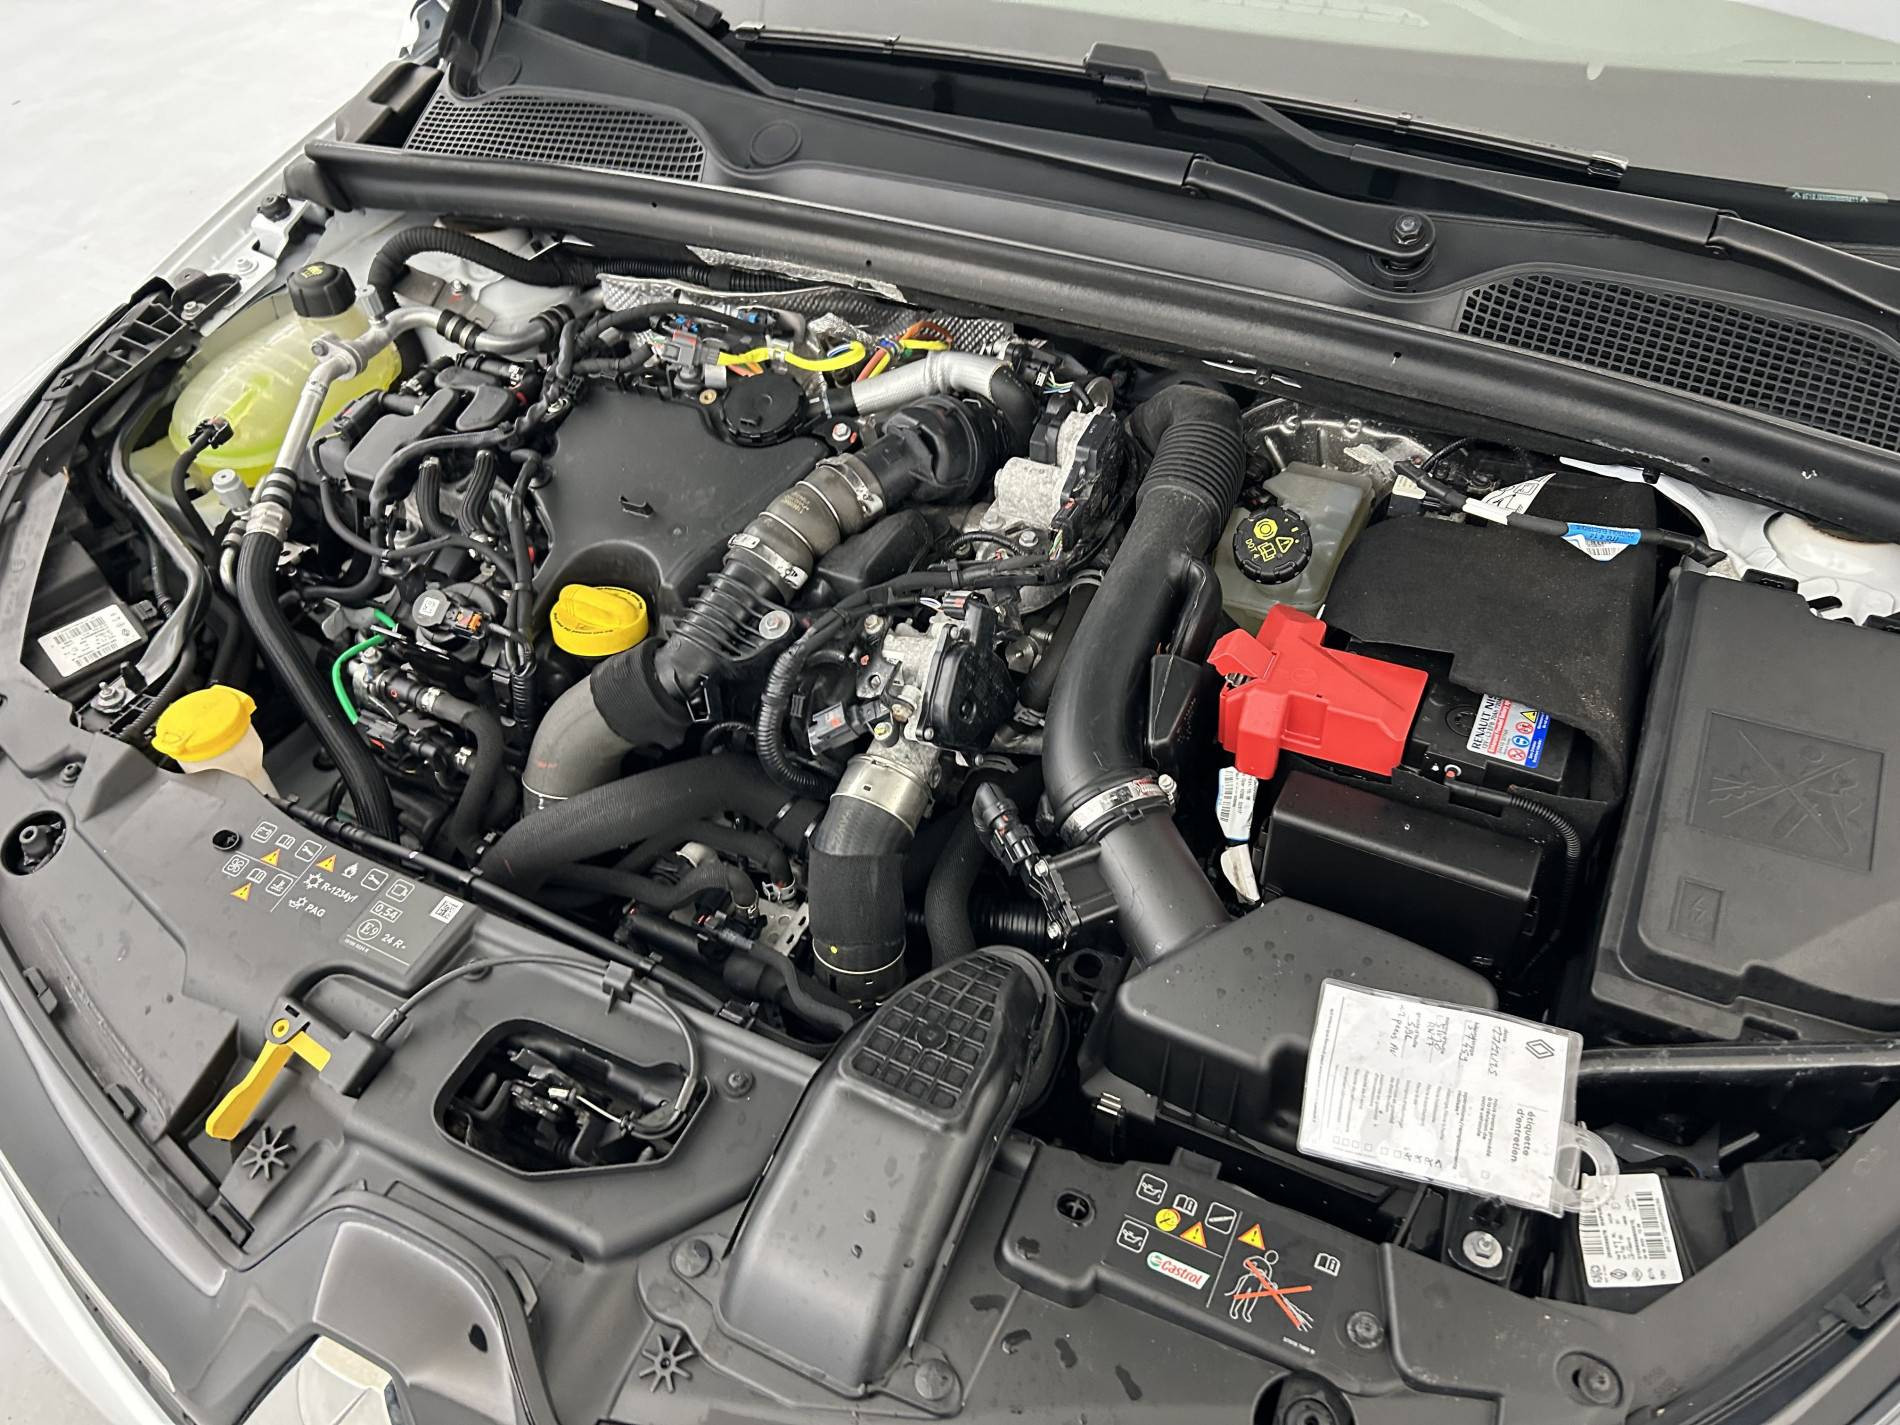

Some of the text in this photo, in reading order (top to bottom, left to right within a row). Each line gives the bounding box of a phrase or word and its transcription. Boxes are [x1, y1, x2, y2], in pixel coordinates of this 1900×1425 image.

[1245, 538, 1258, 553] DOT
[1471, 711, 1491, 749] RENAULT
[320, 881, 358, 904] R-1234yf
[304, 903, 326, 917] PAG
[375, 903, 398, 920] 0,54
[360, 922, 379, 937] E9
[382, 933, 394, 944] 24
[1522, 1111, 1535, 1156] étiquette
[1161, 1260, 1203, 1285] Castrol
